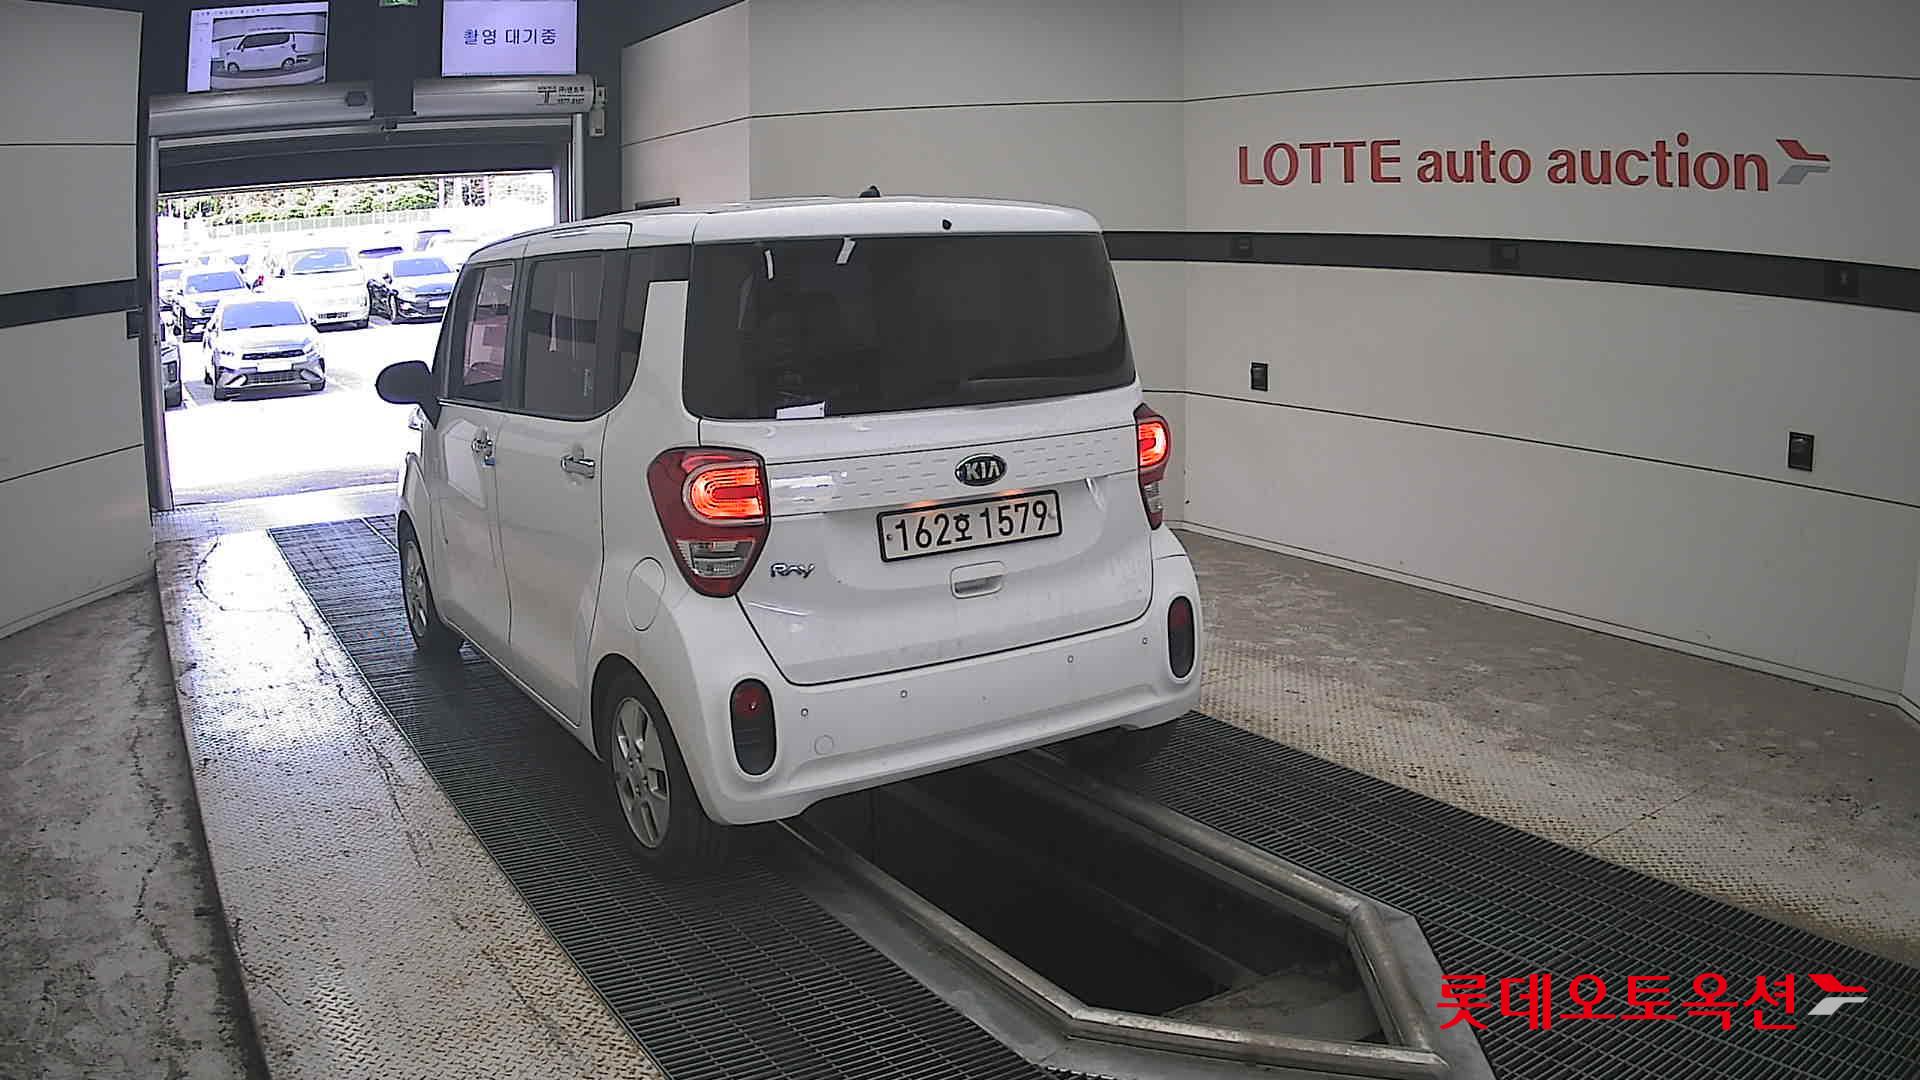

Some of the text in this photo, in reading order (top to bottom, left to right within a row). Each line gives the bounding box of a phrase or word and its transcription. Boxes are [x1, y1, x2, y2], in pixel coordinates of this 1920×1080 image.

[505, 28, 557, 45] 대기중
[1239, 132, 1769, 192] LOTTE auto auction
[964, 458, 998, 482] KIA
